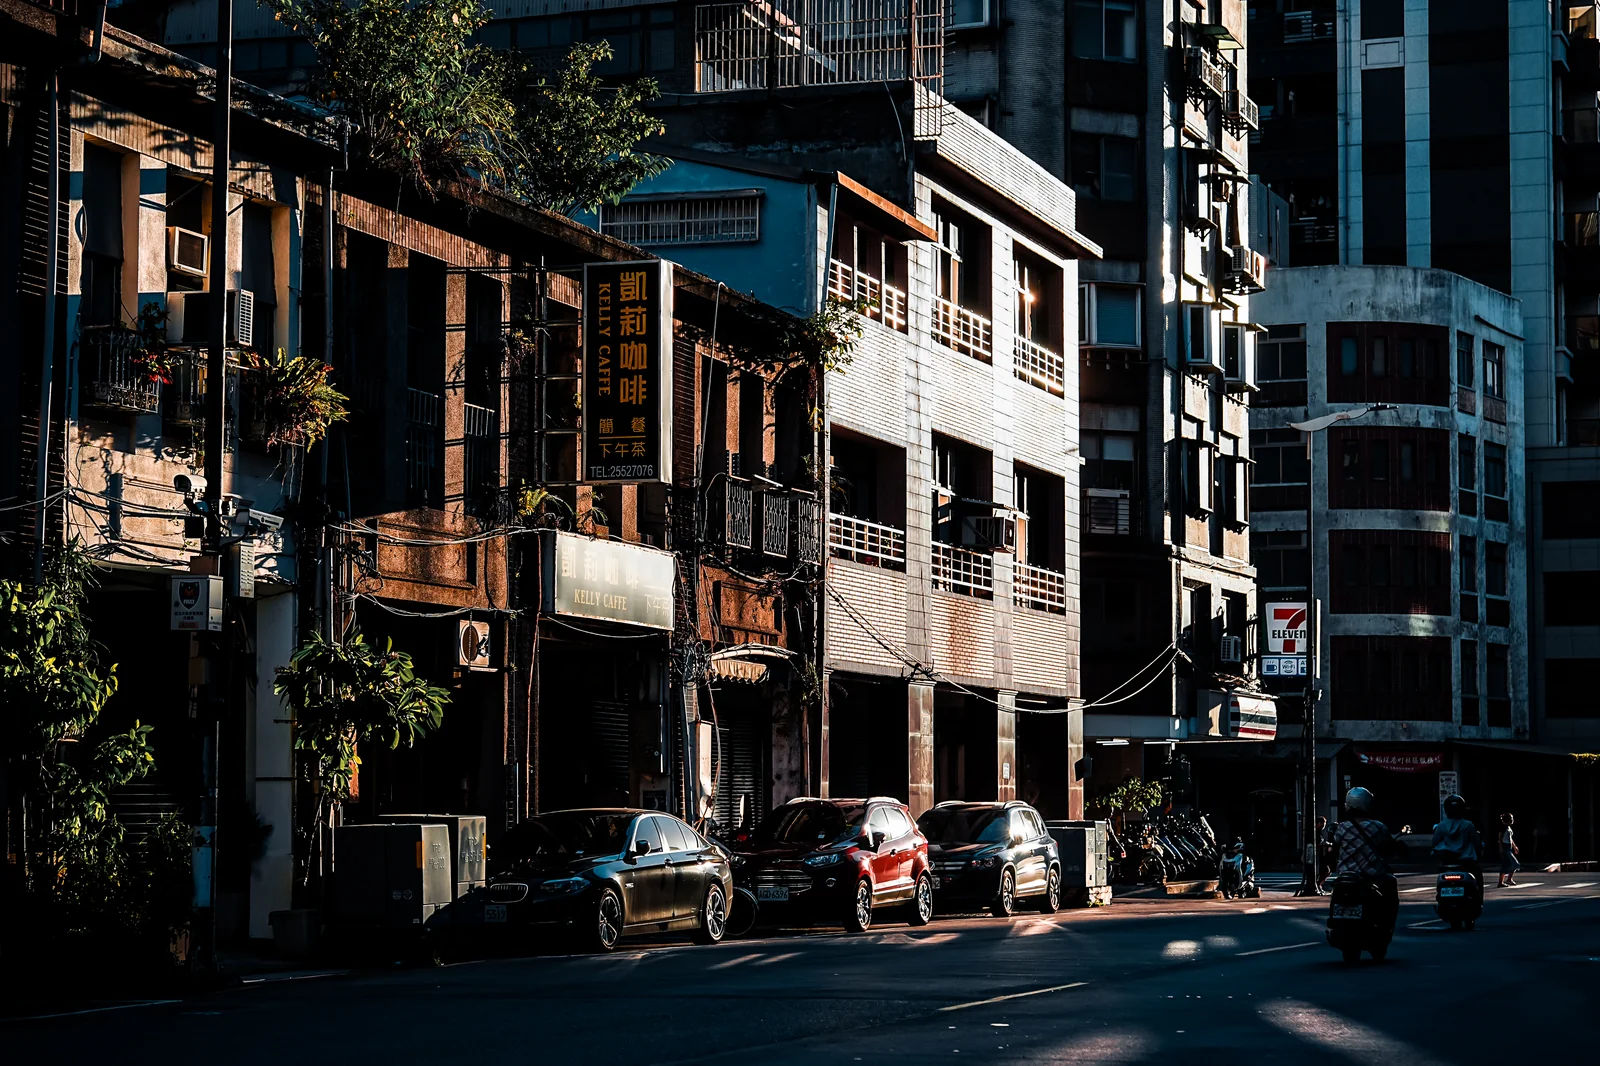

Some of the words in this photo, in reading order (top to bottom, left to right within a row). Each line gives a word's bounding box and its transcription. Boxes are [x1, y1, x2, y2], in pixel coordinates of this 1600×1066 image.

[598, 283, 611, 337] KELLY
[619, 271, 648, 405] 凱莉咖啡
[598, 344, 611, 396] CAFFE
[599, 440, 647, 458] 下午茶
[590, 464, 653, 478] TEL:25527076
[574, 588, 601, 607] KELLY
[603, 593, 628, 611] CAFFE
